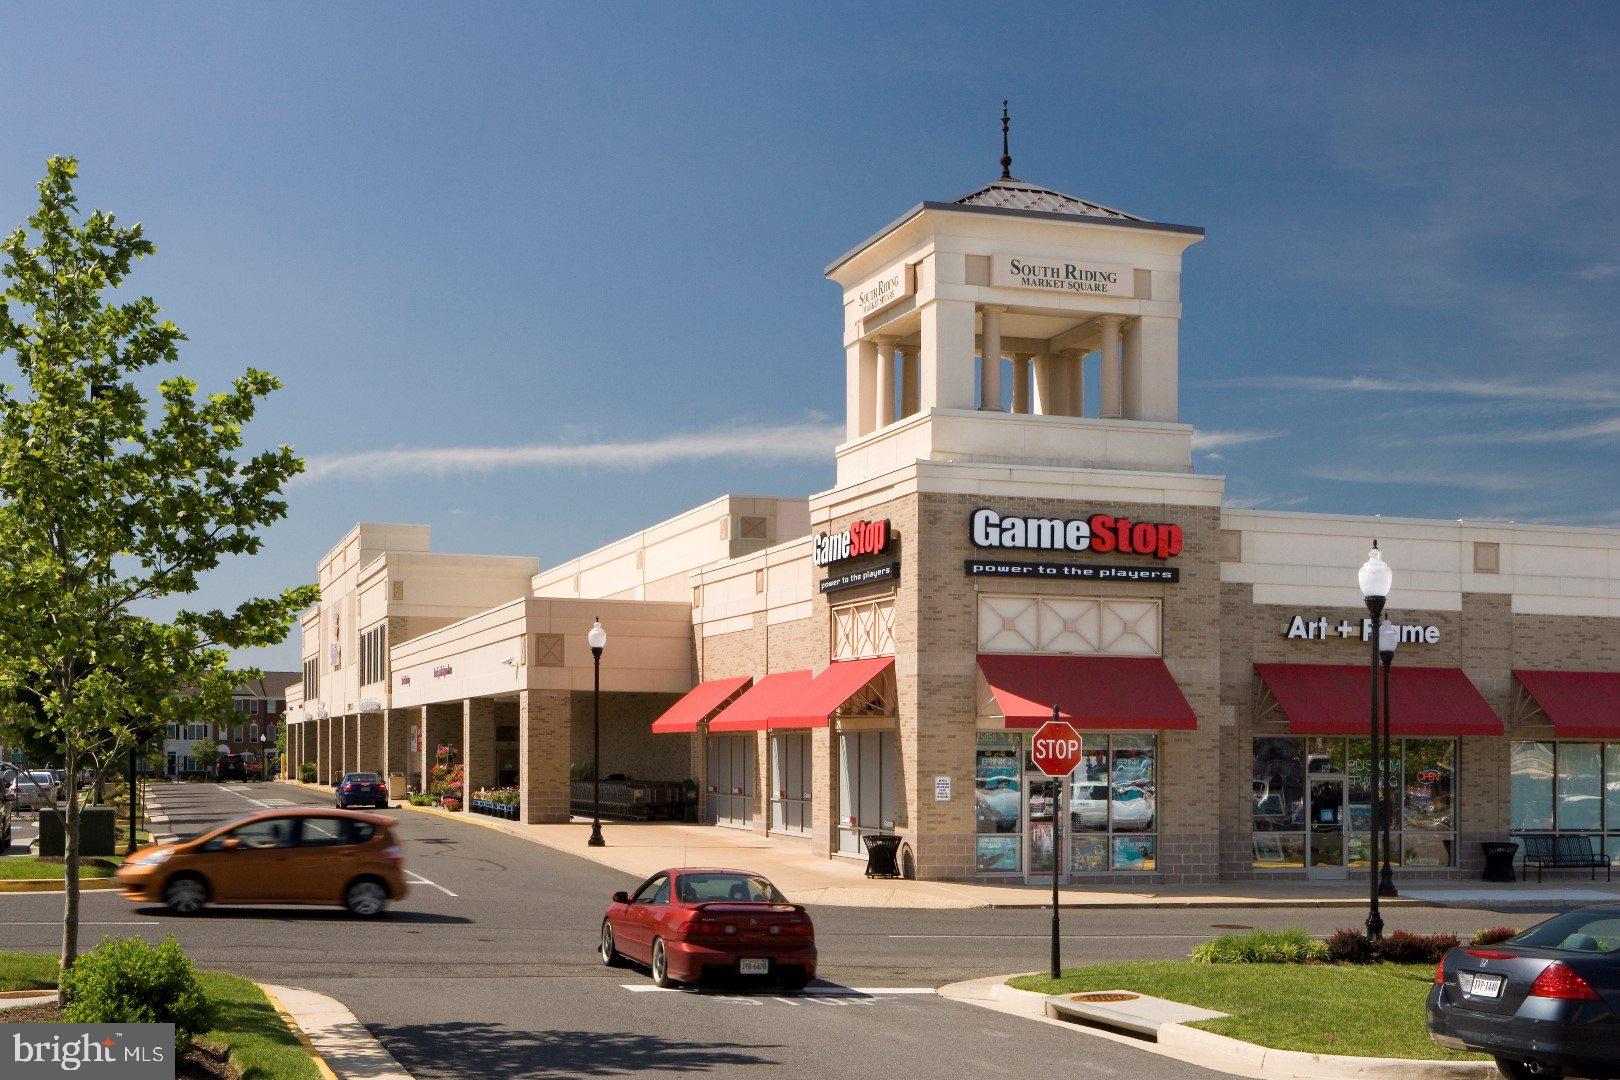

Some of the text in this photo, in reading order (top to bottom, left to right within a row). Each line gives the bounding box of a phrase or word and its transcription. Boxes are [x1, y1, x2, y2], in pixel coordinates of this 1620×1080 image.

[1010, 259, 1117, 283] SOUTH RIDING
[1021, 278, 1108, 293] MARKET SQUARE
[813, 519, 886, 566] GameStop
[972, 508, 1183, 558] GameStop
[820, 579, 841, 590] power
[850, 573, 862, 582] the
[862, 567, 890, 580] players
[973, 564, 1173, 579] power to the players
[1287, 615, 1441, 644] Art + Fme
[1035, 738, 1079, 759] STOP
[1416, 771, 1441, 781] OPEN
